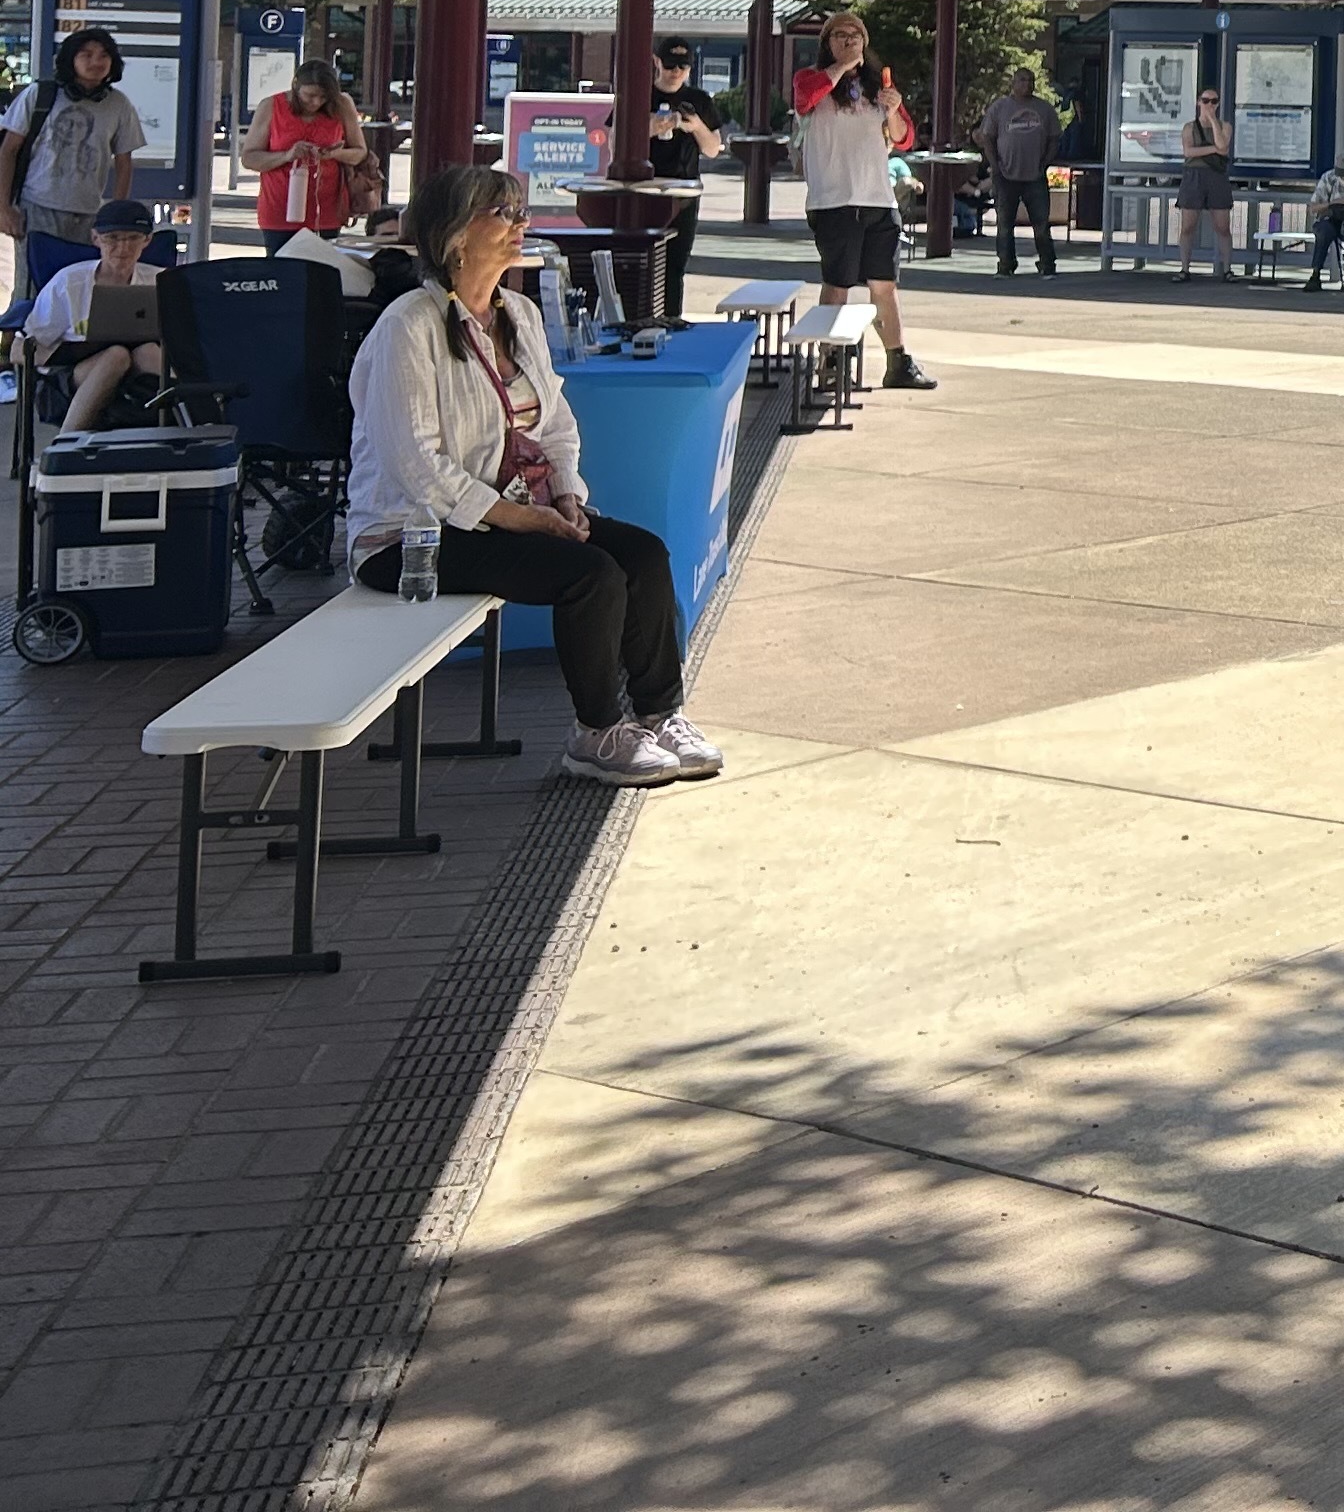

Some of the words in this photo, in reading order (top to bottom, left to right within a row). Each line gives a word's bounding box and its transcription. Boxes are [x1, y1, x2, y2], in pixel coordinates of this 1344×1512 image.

[61, 20, 82, 32] 82
[533, 141, 586, 153] SERVICE
[533, 152, 584, 163] ALERTS
